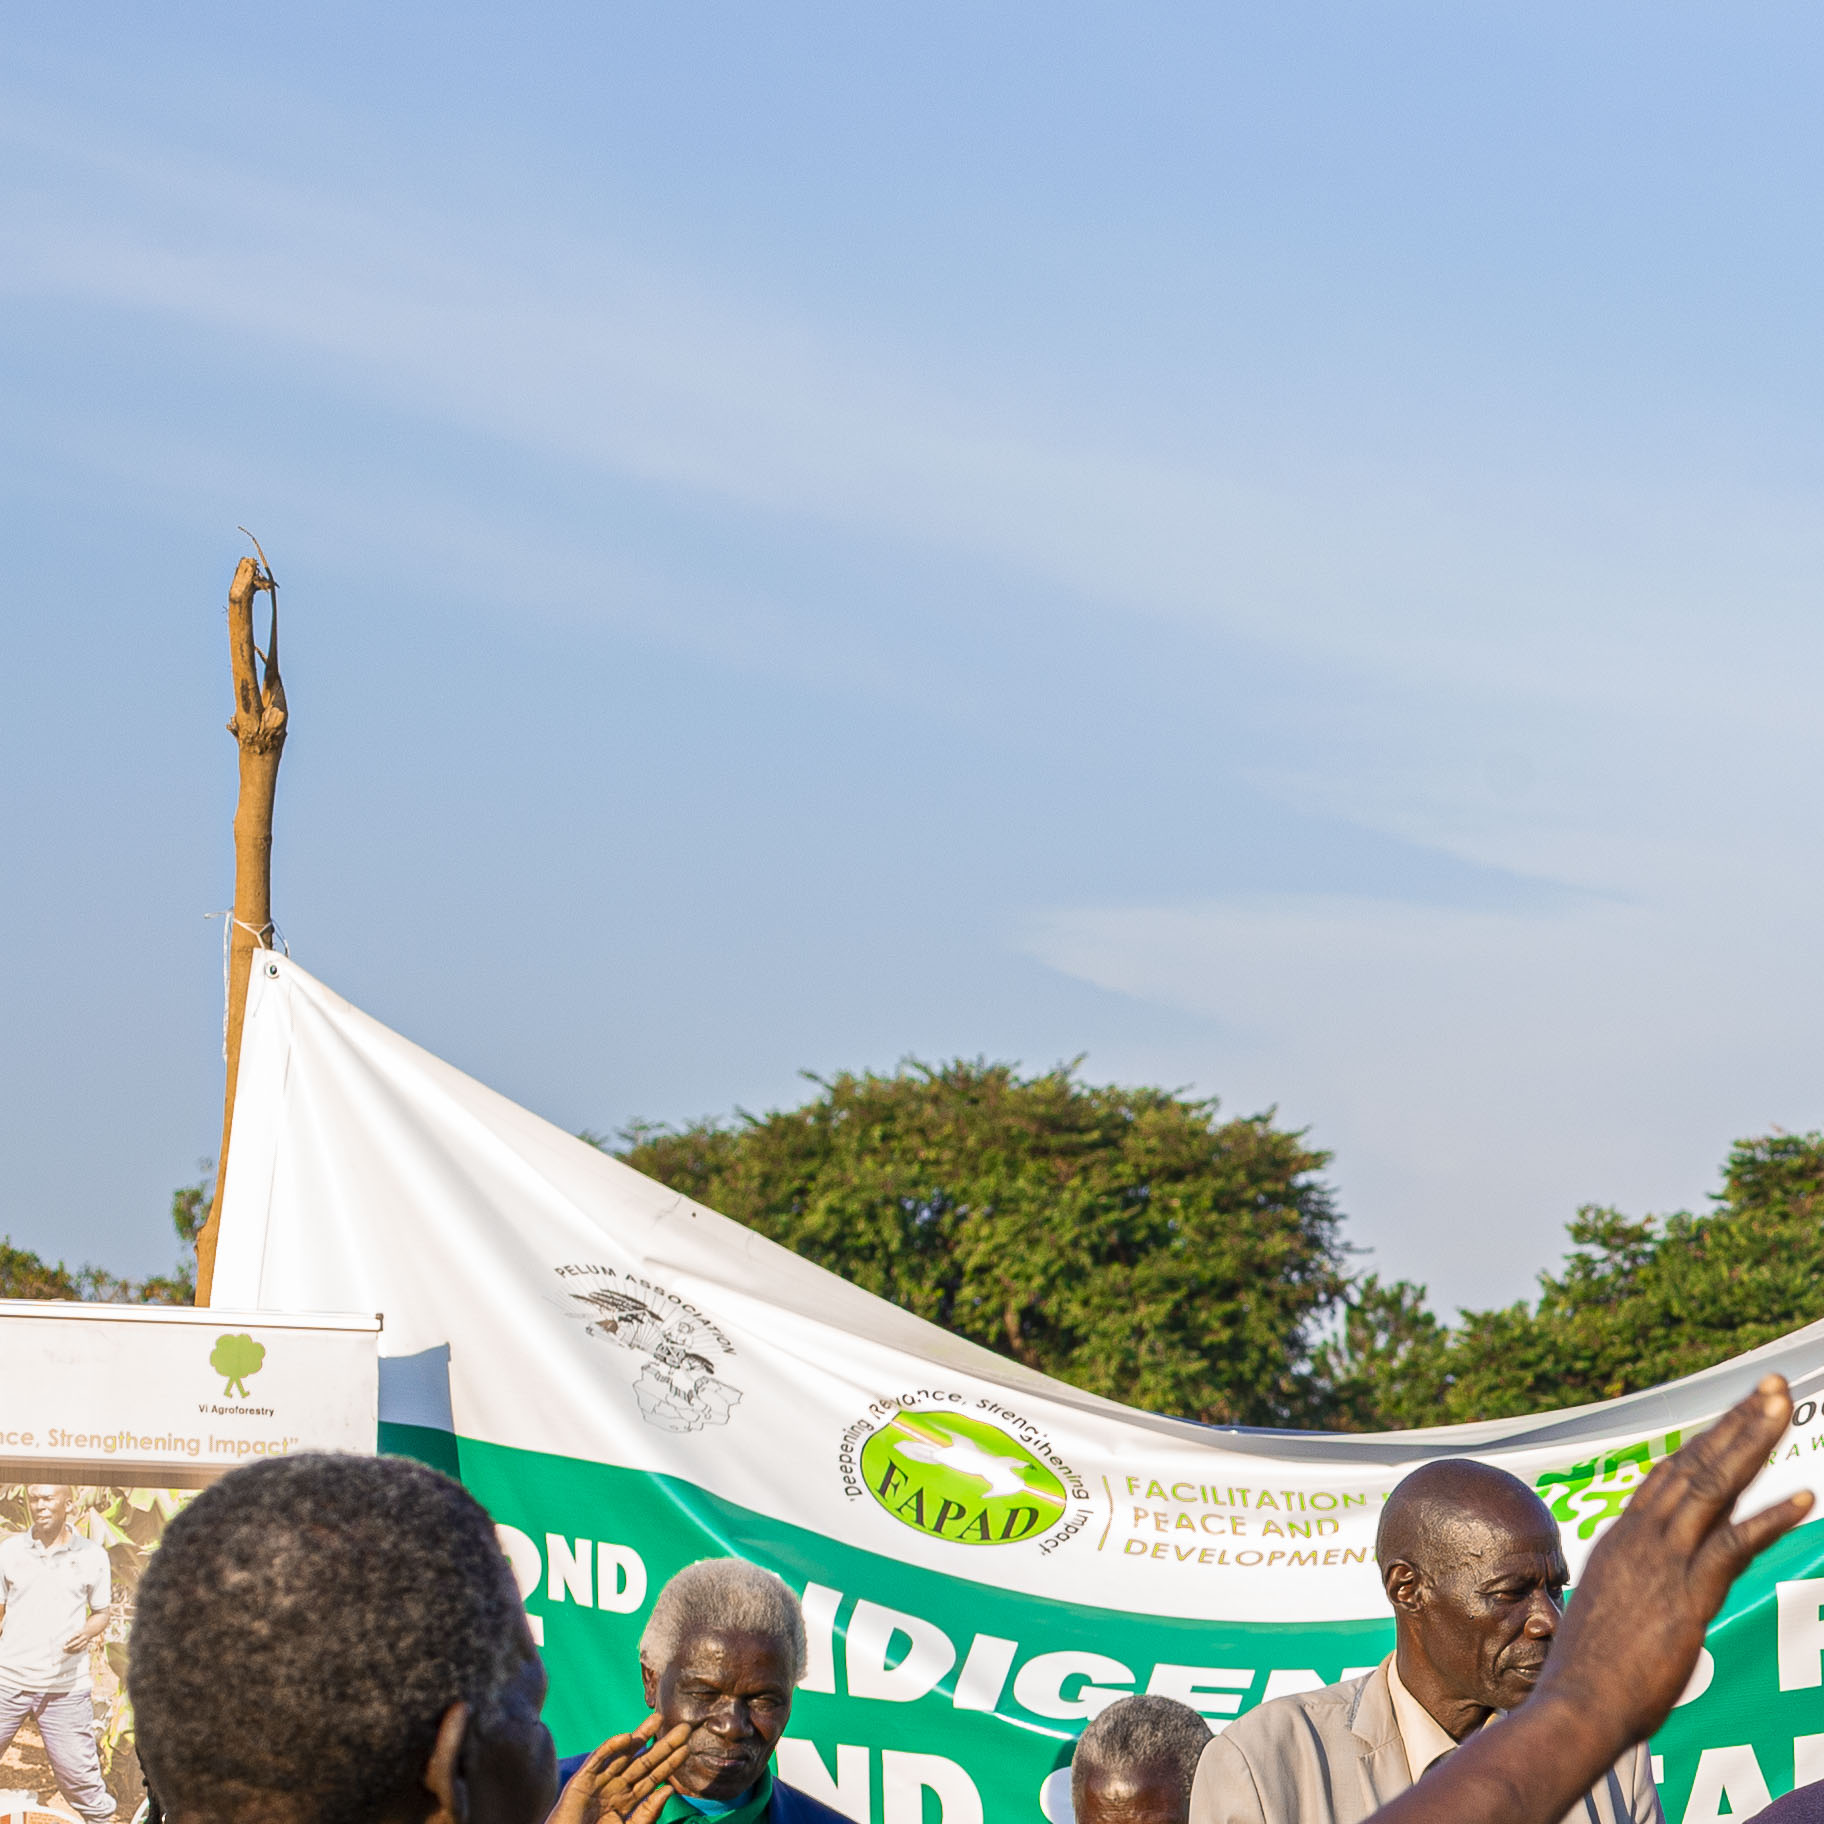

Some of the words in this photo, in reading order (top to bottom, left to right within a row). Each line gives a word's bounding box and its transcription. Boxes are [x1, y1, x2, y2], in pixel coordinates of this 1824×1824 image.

[554, 1264, 617, 1279] PELUM
[625, 1274, 738, 1356] ASSOCIATION
[199, 1404, 209, 1414] Vi
[212, 1404, 275, 1417] Agroforestry
[48, 1428, 201, 1456] Strengthening
[1785, 1443, 1800, 1461] A
[875, 1457, 1040, 1541] FAPAD
[1126, 1476, 1367, 1512] FACILITATION
[1133, 1506, 1248, 1537] PEACE
[1262, 1518, 1341, 1539] AND
